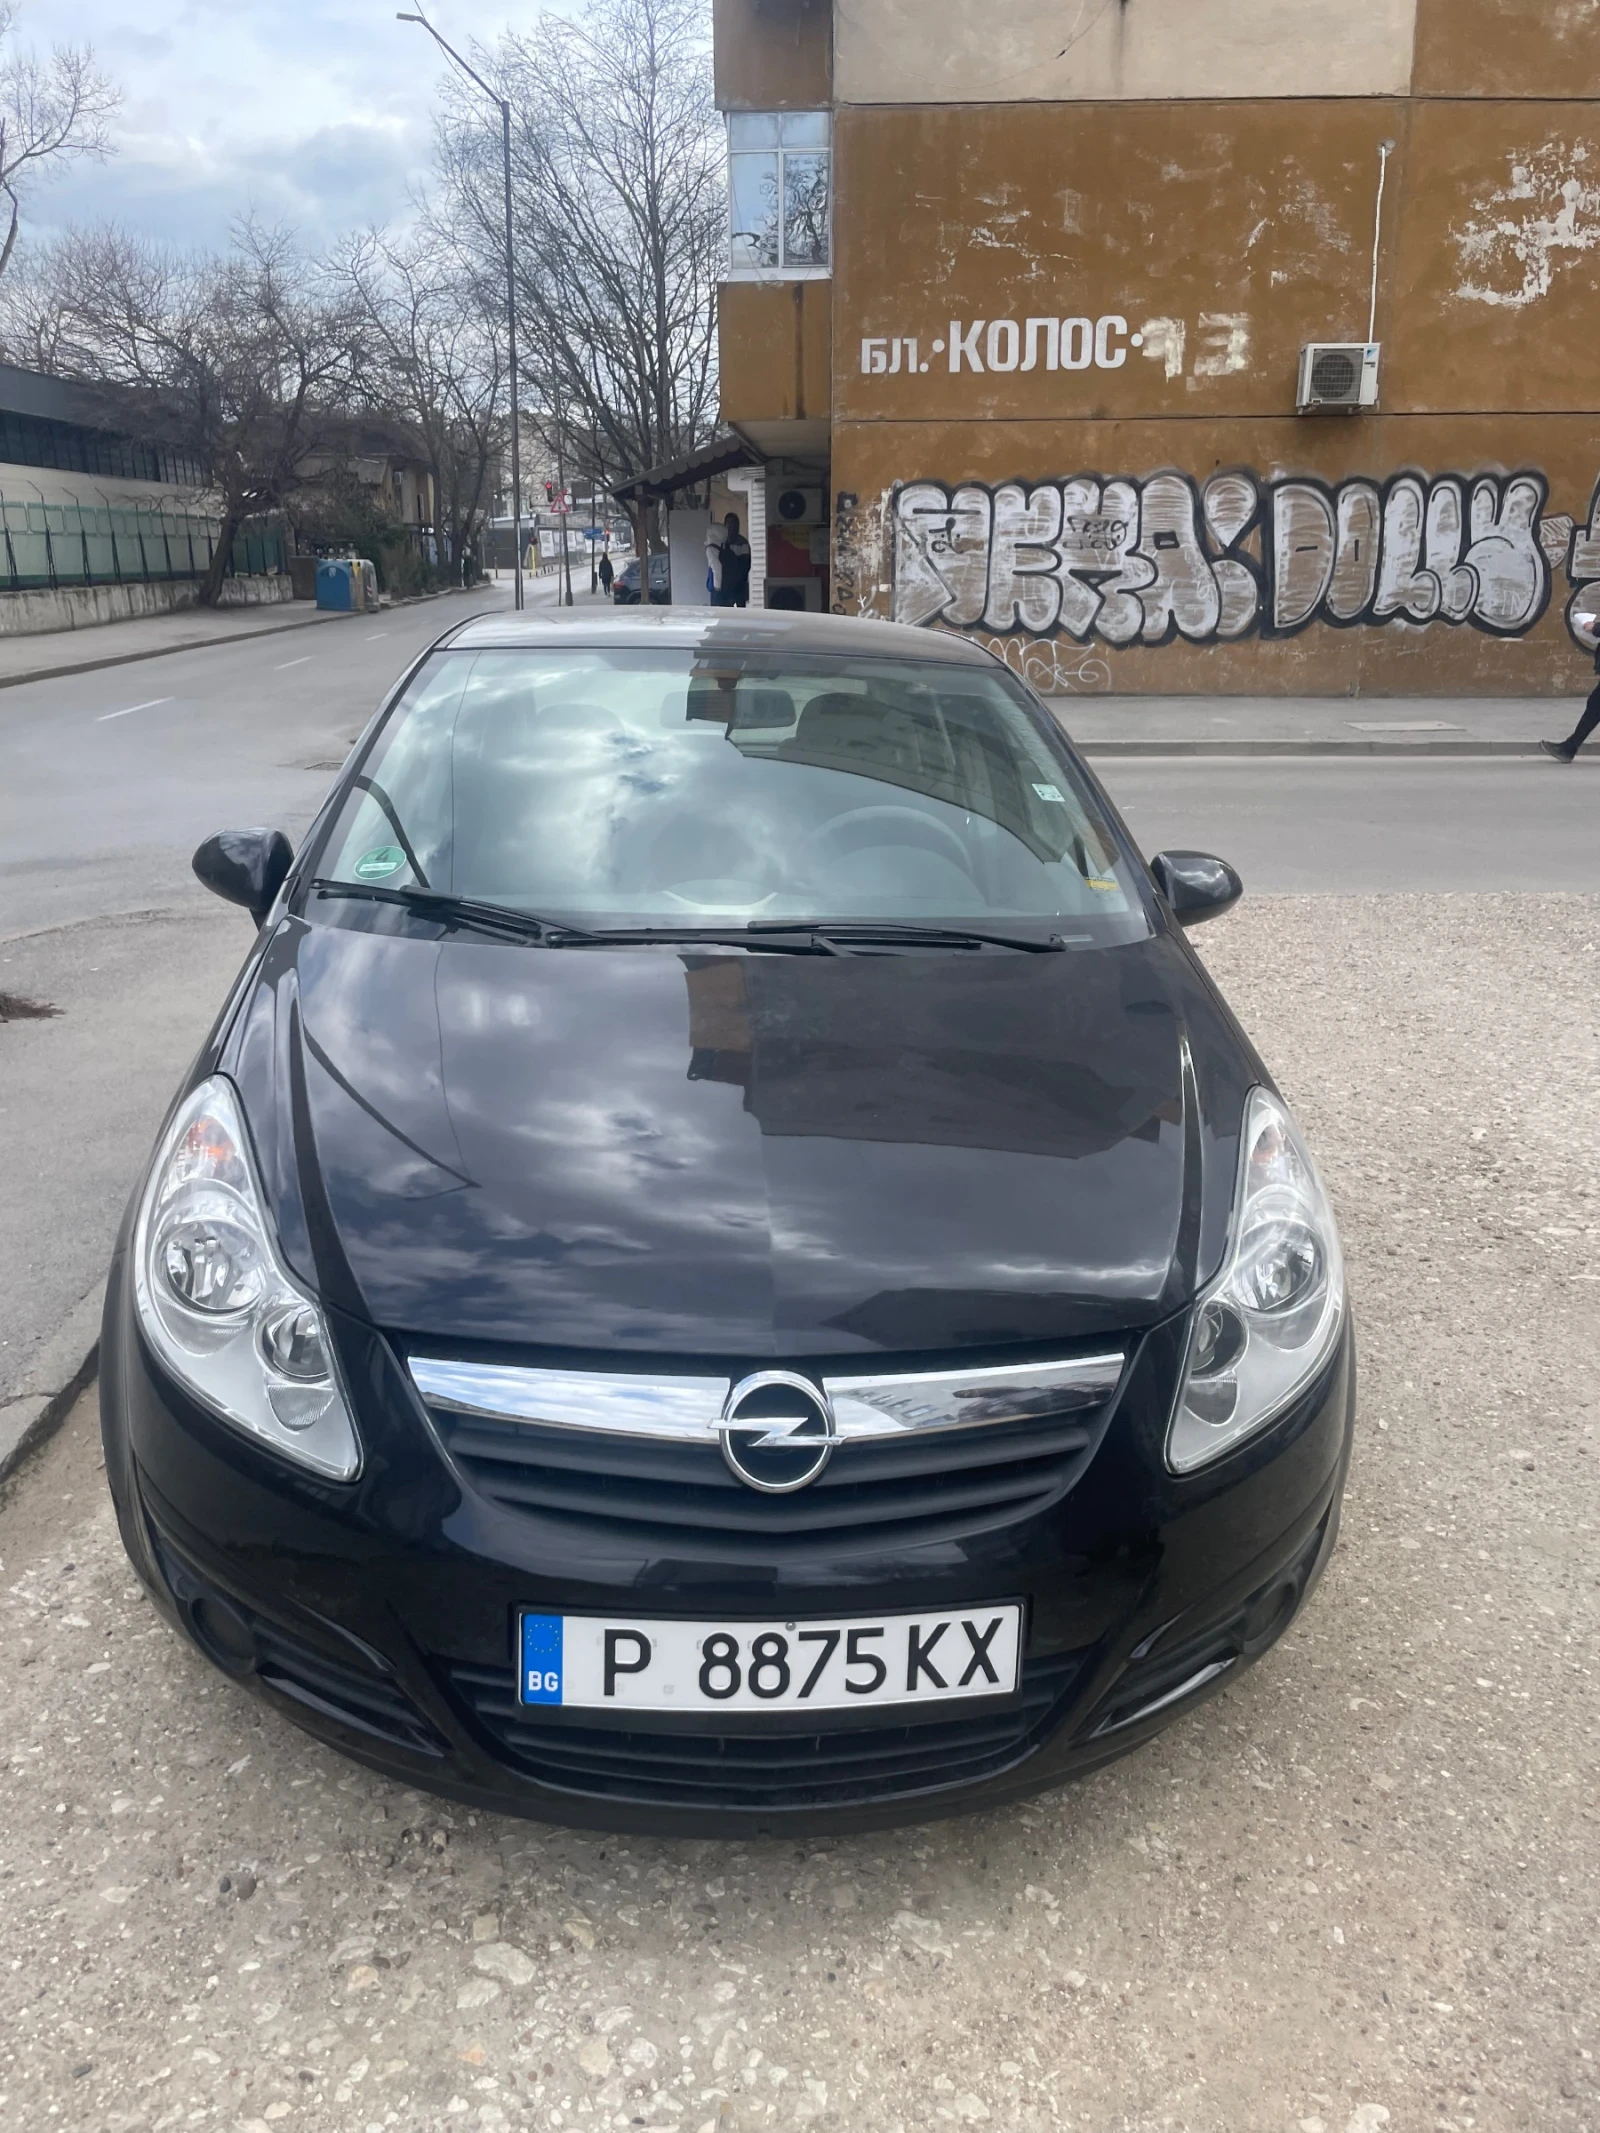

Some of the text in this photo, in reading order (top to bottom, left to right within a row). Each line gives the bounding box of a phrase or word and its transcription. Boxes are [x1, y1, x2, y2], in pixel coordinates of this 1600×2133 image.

[948, 315, 1128, 373] КОЛОС
[528, 1670, 559, 1692] BG
[603, 1616, 1005, 1699] P 8875 KX
